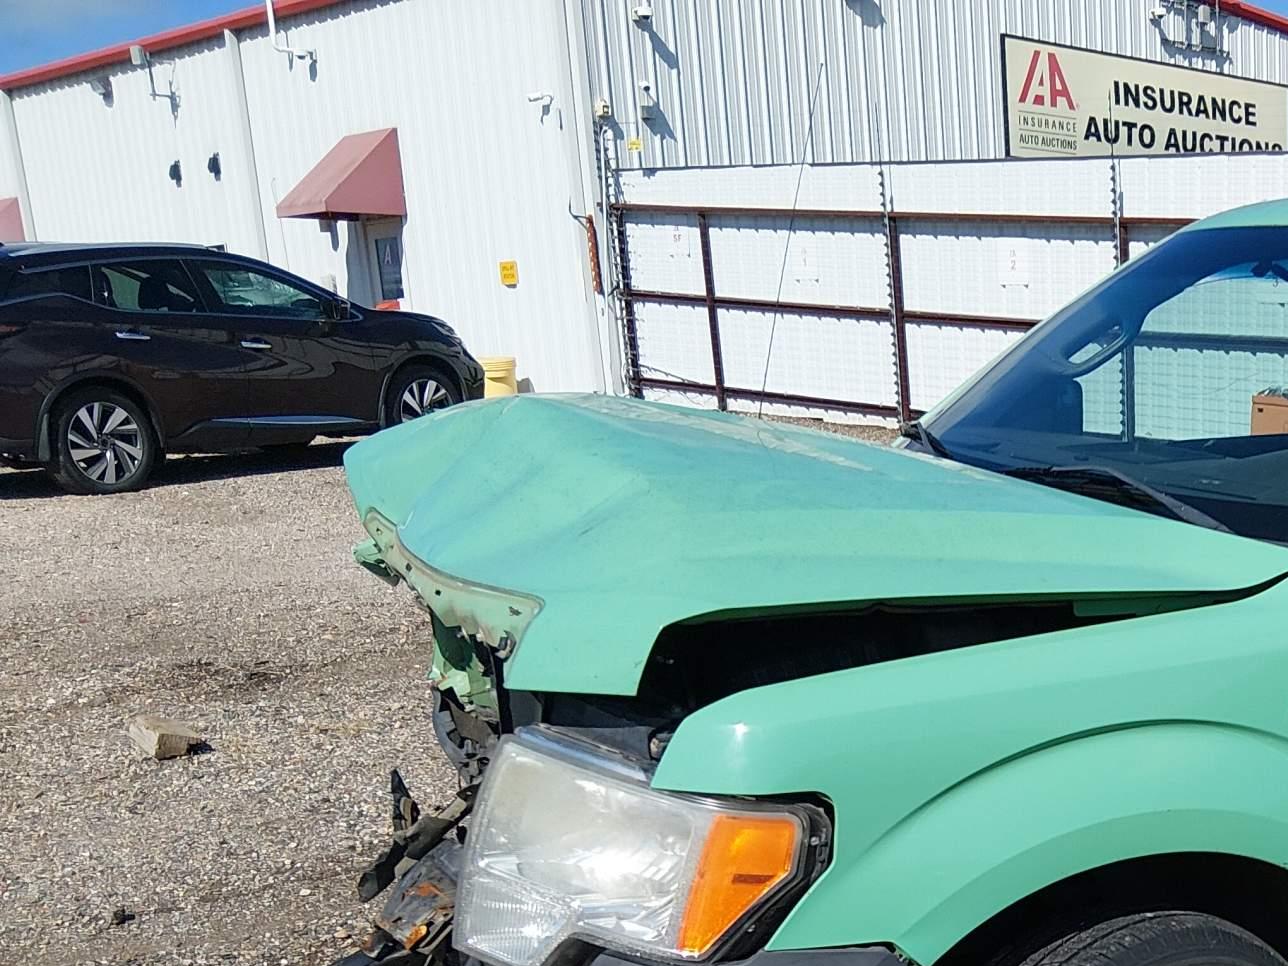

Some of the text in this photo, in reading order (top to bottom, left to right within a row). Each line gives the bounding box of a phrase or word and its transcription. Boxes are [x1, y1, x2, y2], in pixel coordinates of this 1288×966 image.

[1113, 80, 1258, 127] INSURANCE
[1018, 115, 1077, 133] INSURANCE
[1083, 116, 1156, 149] AUTO
[1019, 133, 1077, 151] AUTO AUCTIONS
[384, 243, 392, 265] A
